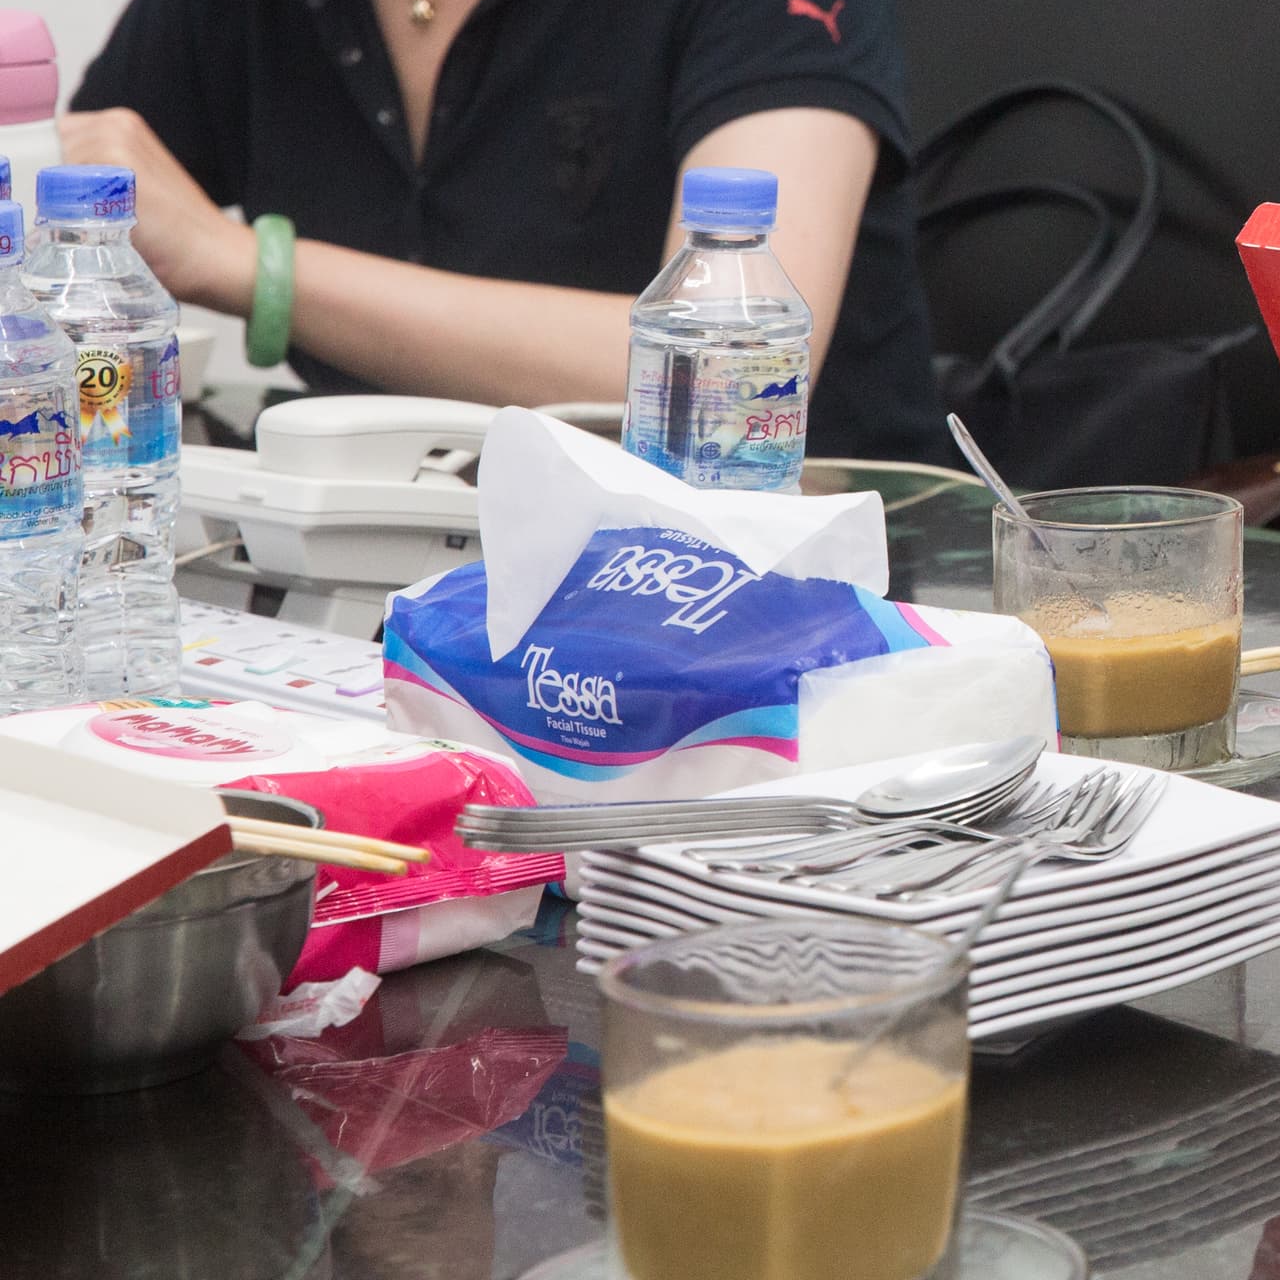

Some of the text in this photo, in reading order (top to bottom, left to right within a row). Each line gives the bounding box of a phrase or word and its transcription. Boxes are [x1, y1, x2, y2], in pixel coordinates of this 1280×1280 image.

[80, 366, 114, 389] 20
[586, 545, 763, 635] Tessa
[520, 643, 624, 726] Tessa
[546, 716, 607, 739] Facial Tissue
